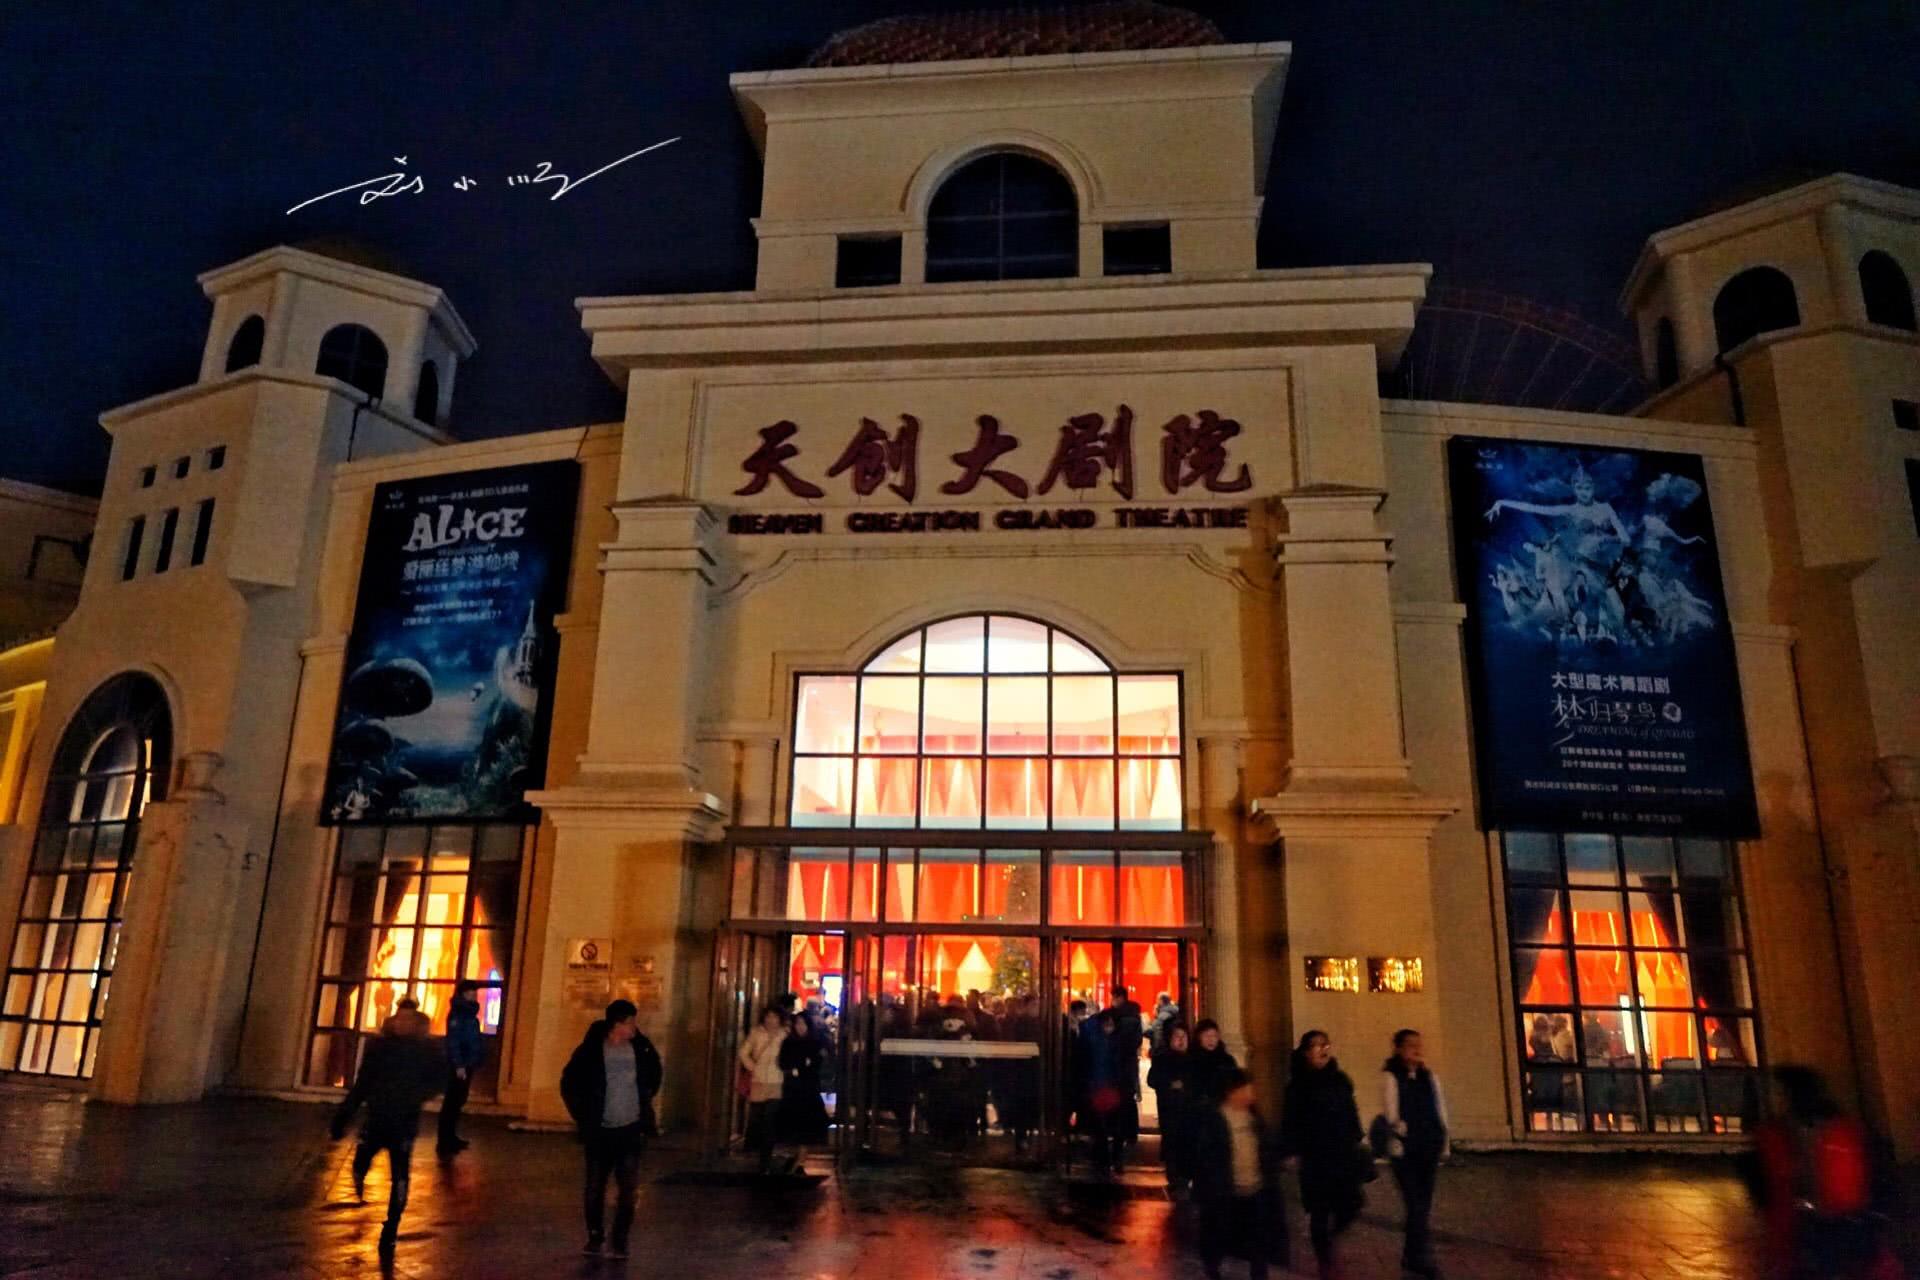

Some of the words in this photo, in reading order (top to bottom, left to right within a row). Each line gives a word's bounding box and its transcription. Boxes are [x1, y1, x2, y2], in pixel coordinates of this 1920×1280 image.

[734, 404, 1252, 502] 天创大剧院
[728, 513, 823, 535] HEAVEN
[848, 511, 980, 533] CREATION
[994, 509, 1096, 531] GRAND
[1113, 507, 1249, 529] THEATRE
